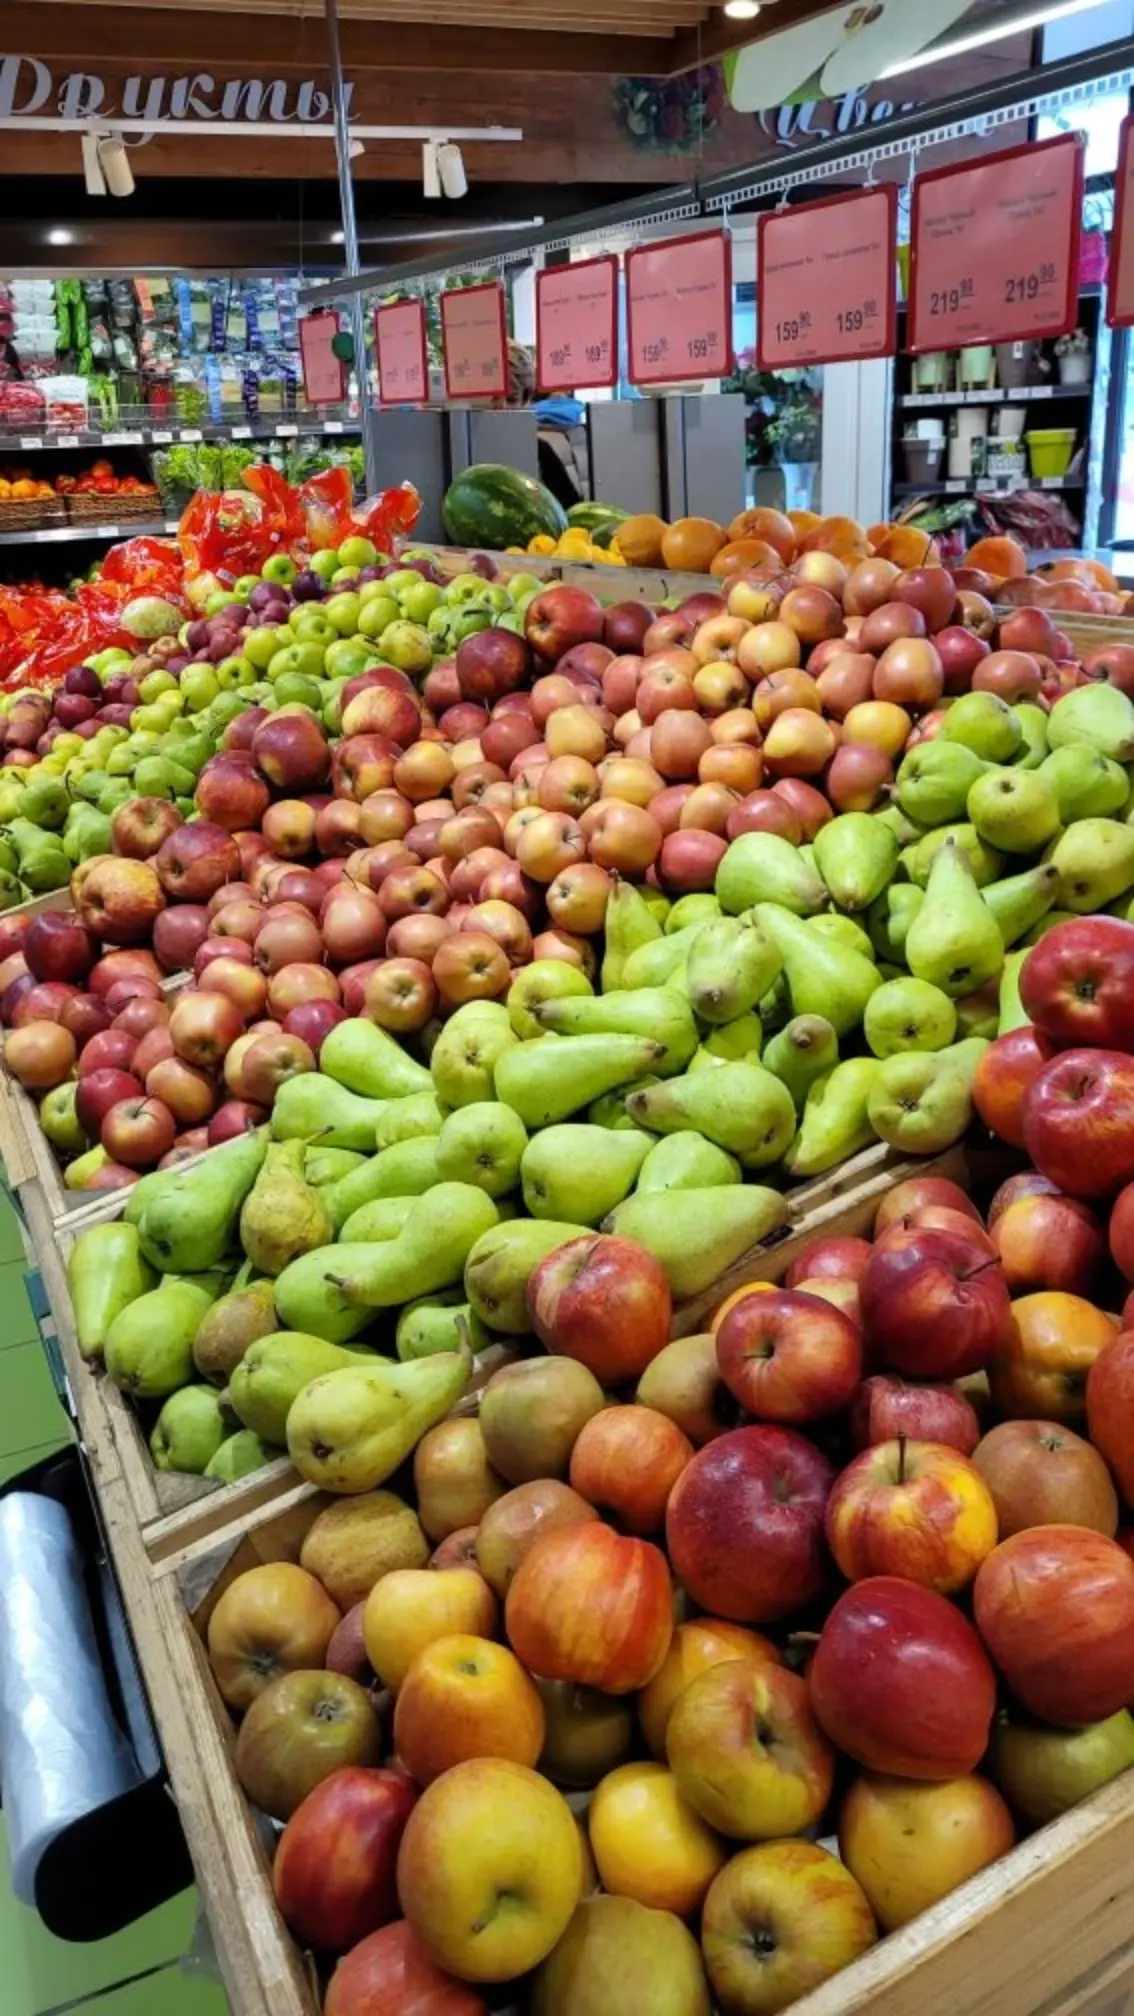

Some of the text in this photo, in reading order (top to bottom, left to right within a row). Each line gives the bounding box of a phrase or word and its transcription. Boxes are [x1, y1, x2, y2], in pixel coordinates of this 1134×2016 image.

[1005, 275, 1039, 303] 219
[930, 289, 960, 315] 219
[776, 320, 799, 343] 159
[837, 310, 863, 333] 159
